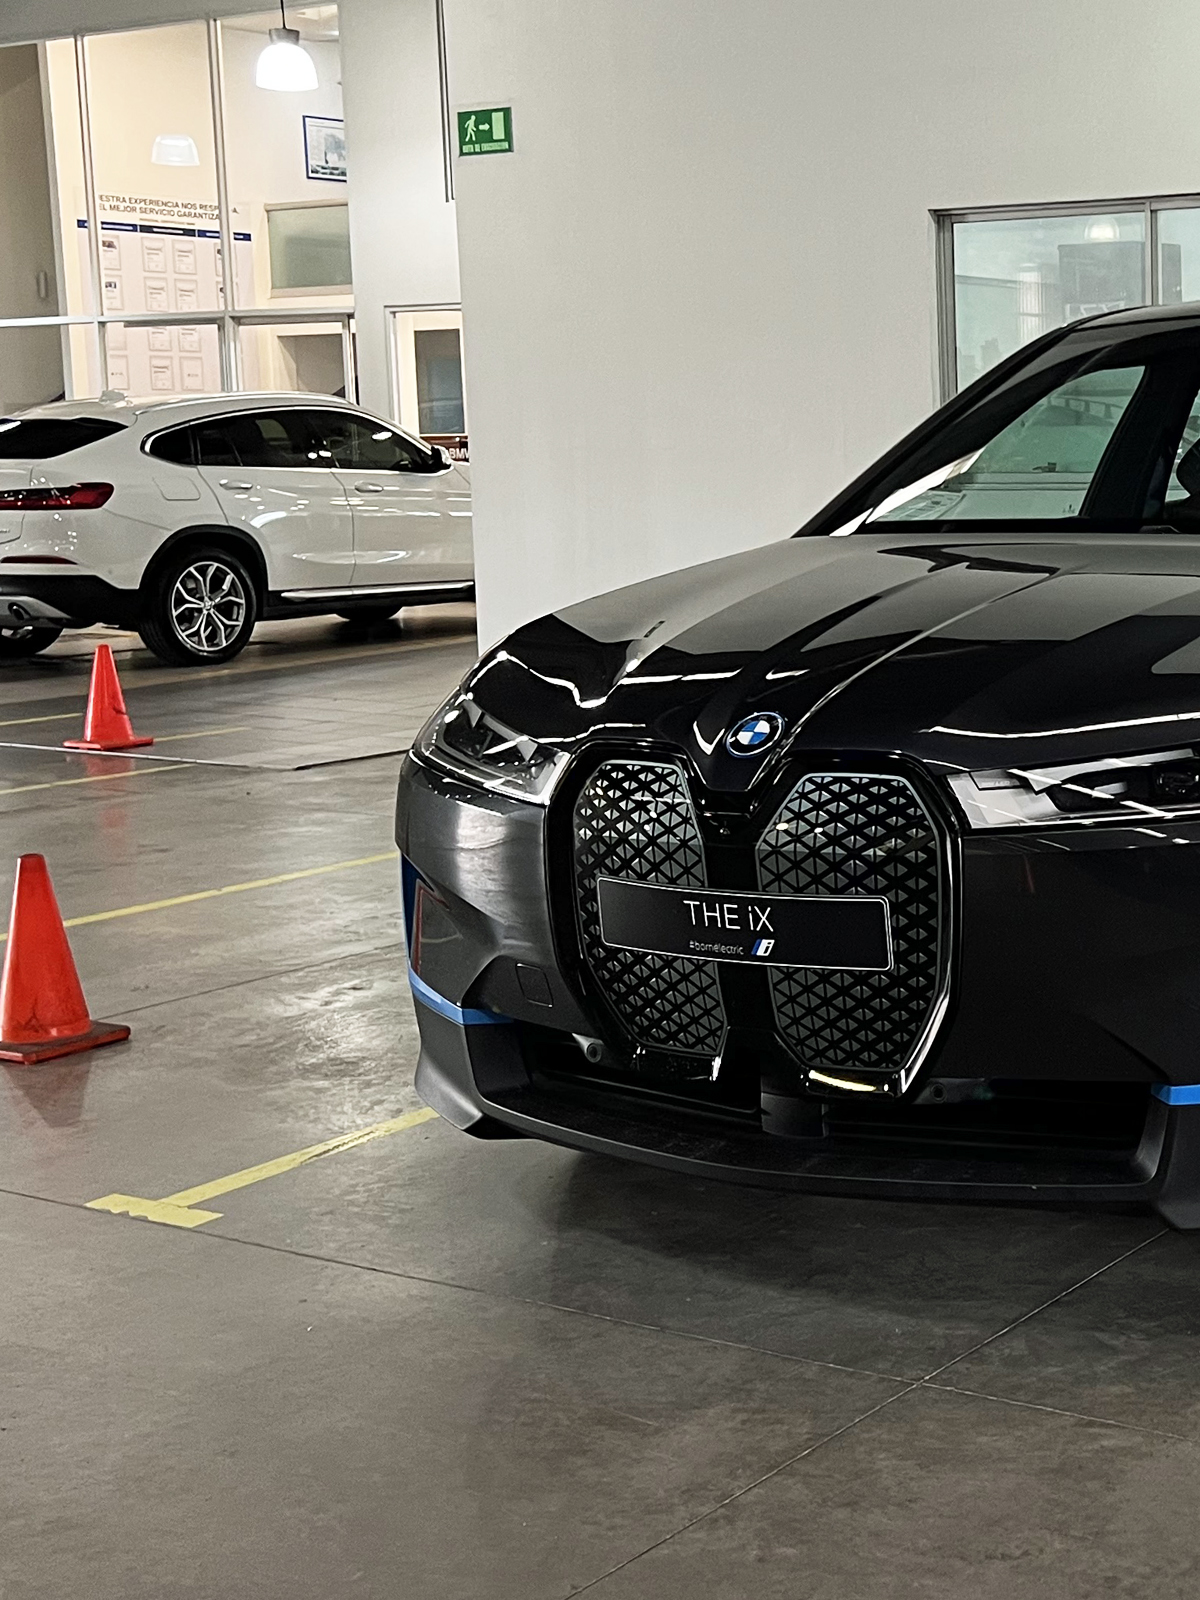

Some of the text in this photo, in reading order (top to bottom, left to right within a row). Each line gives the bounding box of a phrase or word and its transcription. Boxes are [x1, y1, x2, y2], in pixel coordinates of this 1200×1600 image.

[129, 196, 180, 208] EXPERIENCIA
[181, 201, 197, 211] NOS
[109, 204, 137, 213] MEJOR
[139, 206, 176, 217] SERVICIO
[177, 210, 220, 221] GARANTIZA
[683, 900, 774, 932] THE iX
